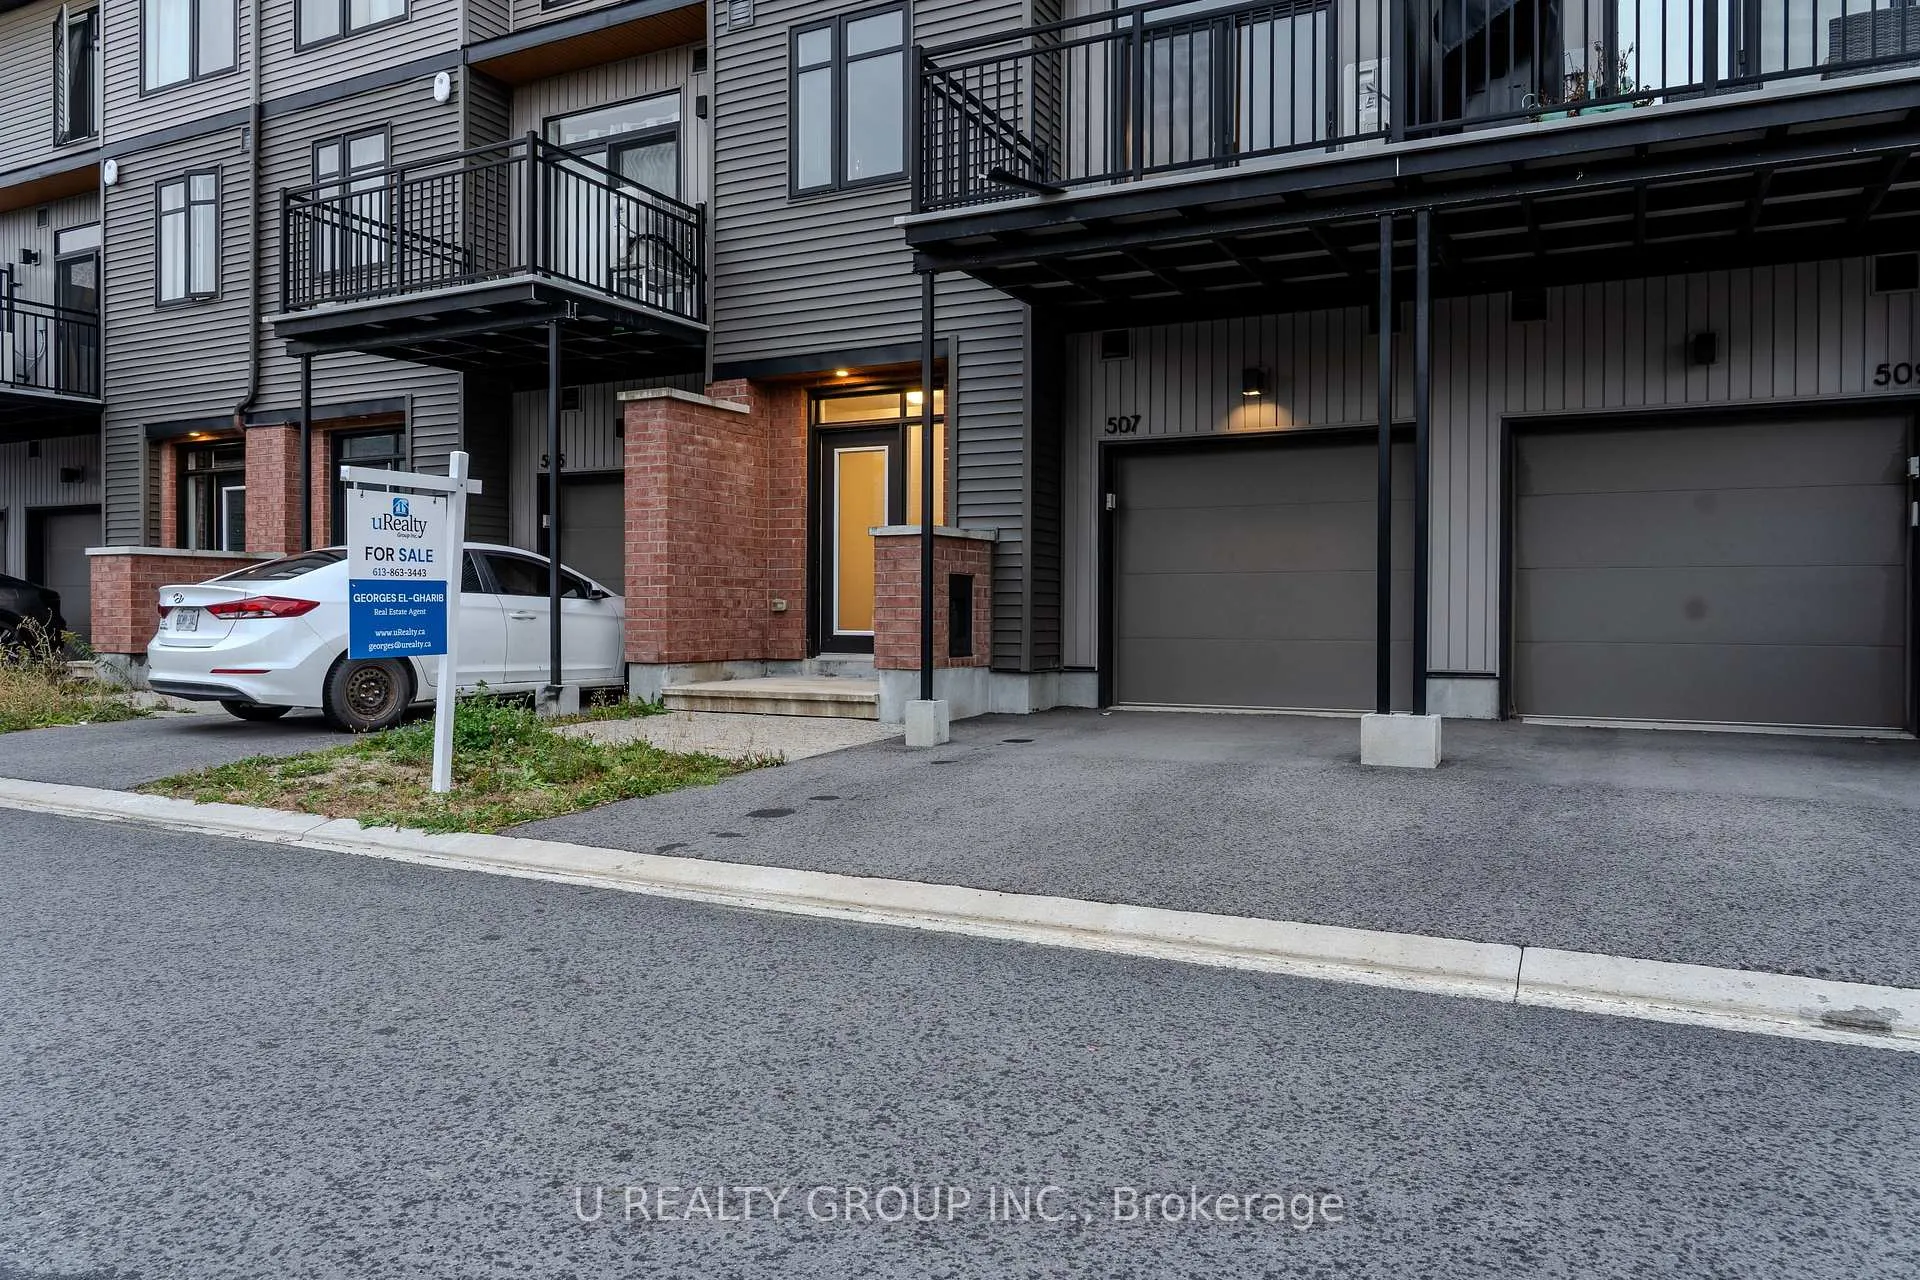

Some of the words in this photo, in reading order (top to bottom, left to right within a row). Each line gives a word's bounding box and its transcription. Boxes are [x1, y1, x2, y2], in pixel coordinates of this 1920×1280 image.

[1105, 414, 1142, 434] 507
[372, 513, 427, 538] uRealty
[365, 546, 395, 562] FOR
[399, 548, 433, 563] SALE
[372, 568, 427, 577] 613-863-3443
[353, 593, 396, 603] GEORGES
[398, 593, 444, 603] EL-GHARIB
[374, 608, 388, 616] Real
[389, 608, 407, 616] Estate
[408, 608, 426, 617] Agent
[375, 628, 426, 637] www.uRealty.ca
[368, 640, 431, 652] georges@urealty.ca
